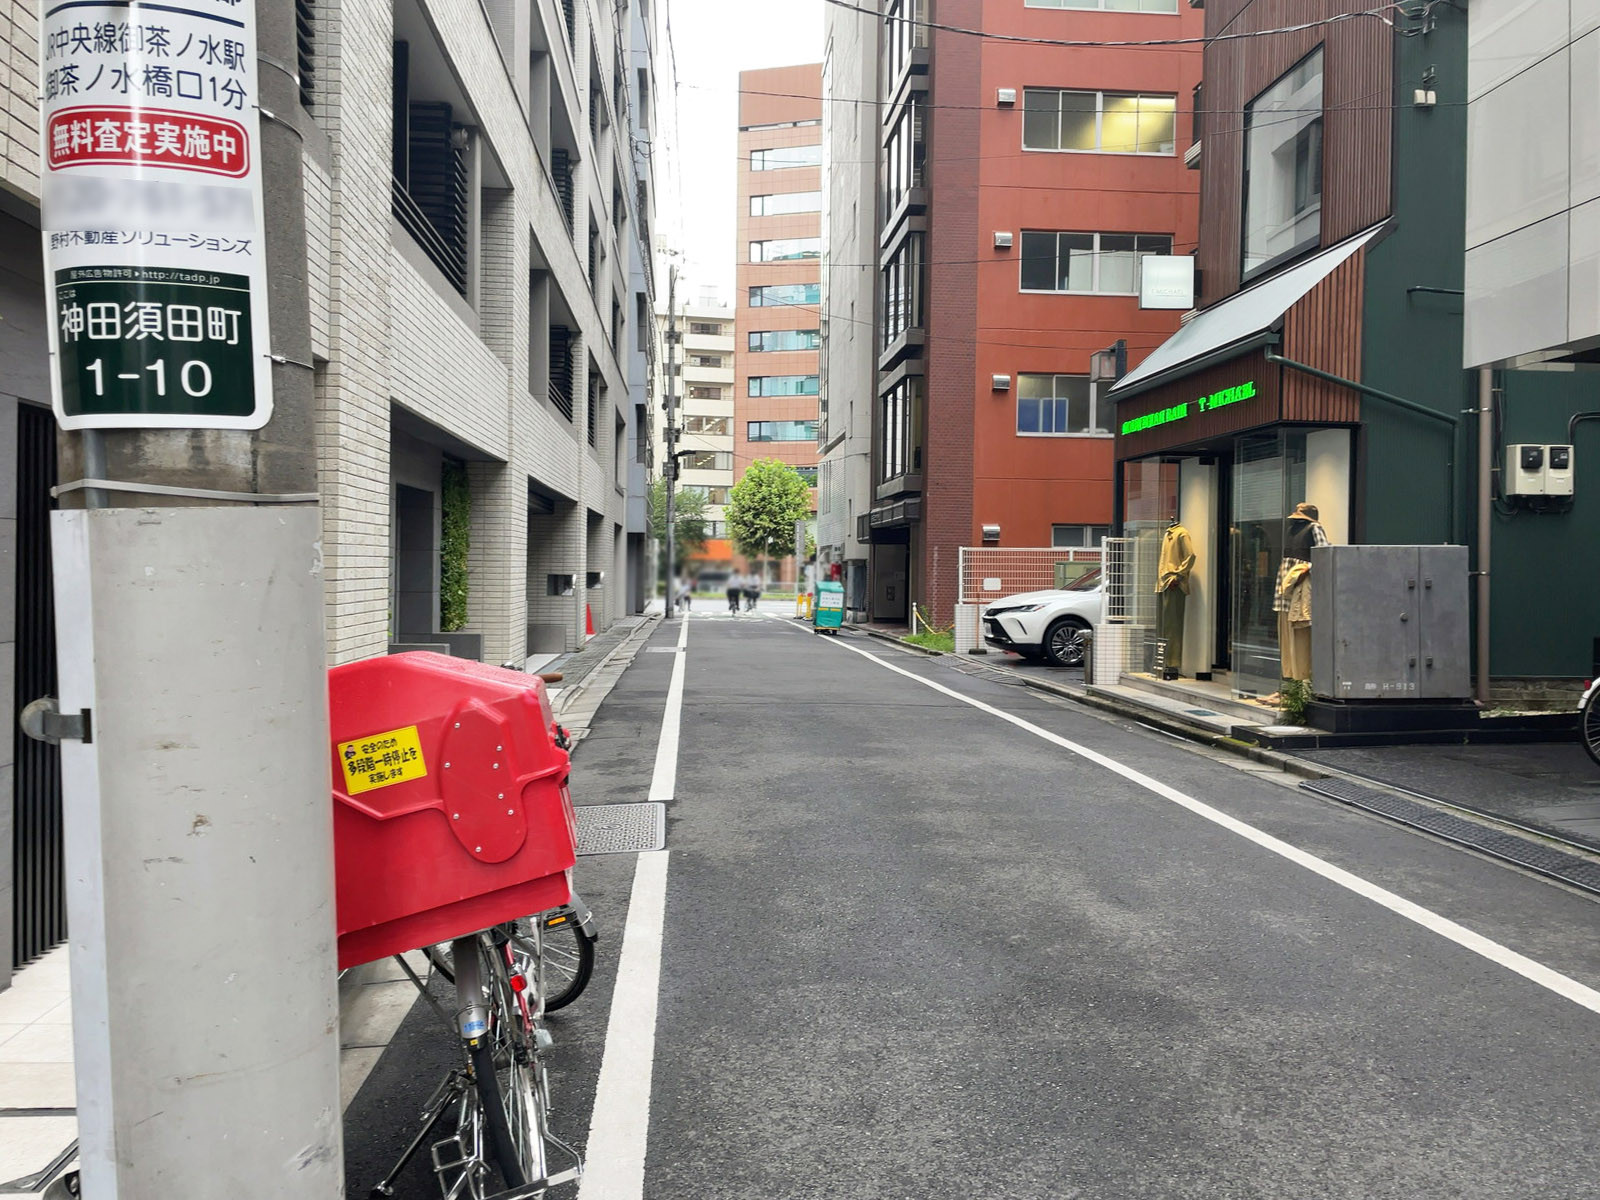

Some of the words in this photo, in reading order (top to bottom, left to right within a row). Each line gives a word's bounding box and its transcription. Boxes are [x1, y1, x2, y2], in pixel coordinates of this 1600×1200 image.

[46, 22, 246, 73] JR中央線御茶ノ水駅
[46, 62, 248, 110] 御茶ノ水橋口1分
[54, 119, 237, 164] 無料査定実施中
[51, 231, 252, 256] 野村不動産ソリューションズ
[61, 301, 242, 345] 神田須田町
[86, 358, 213, 397] 1-10
